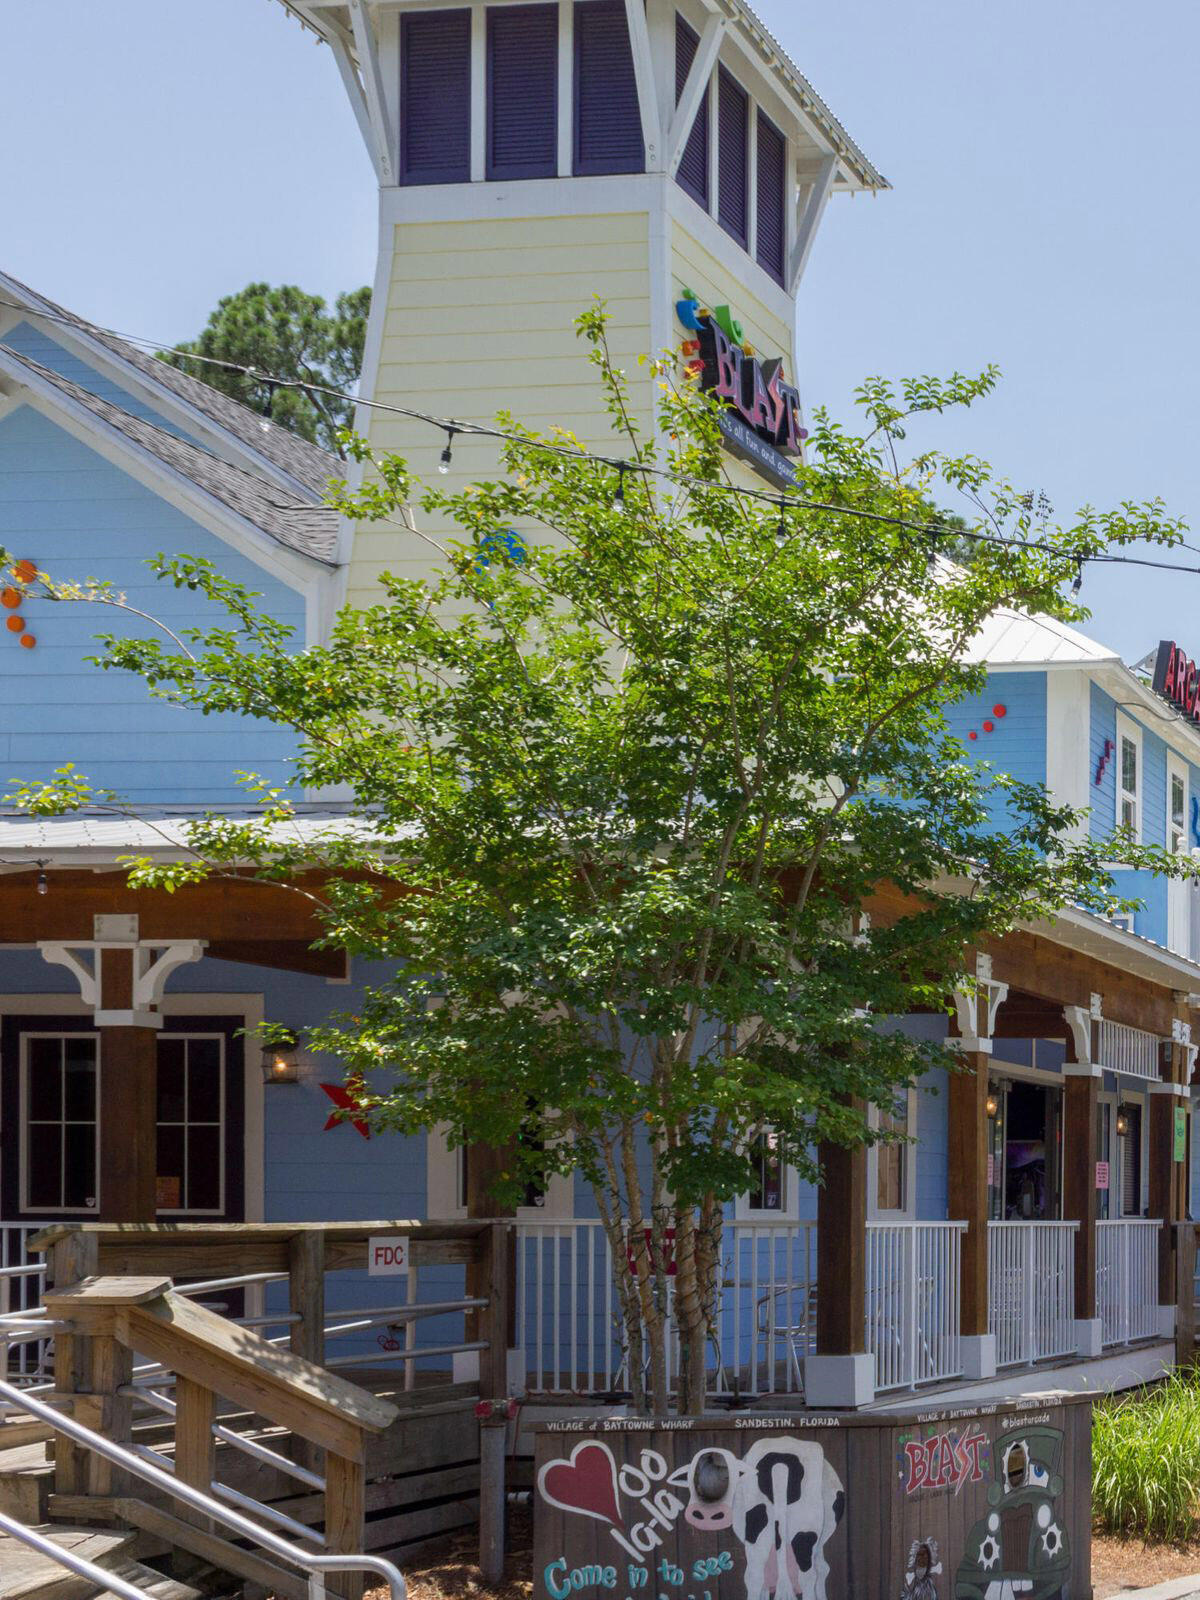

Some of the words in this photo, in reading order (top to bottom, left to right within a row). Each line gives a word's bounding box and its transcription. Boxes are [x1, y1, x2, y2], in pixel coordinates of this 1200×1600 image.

[703, 316, 801, 456] BLAST
[375, 1245, 404, 1266] FDC
[547, 1421, 583, 1431] VILLAGE
[589, 1421, 597, 1430] of
[604, 1420, 655, 1431] BAYTOWNE
[661, 1419, 695, 1430] WHARF
[800, 1417, 840, 1427] FLORIDA
[1002, 1412, 1050, 1429] #blastarcade
[905, 1424, 988, 1496] BLAST
[610, 1489, 686, 1563] la-la
[544, 1556, 617, 1600] Come
[628, 1564, 648, 1589] in
[657, 1558, 684, 1586] to
[693, 1551, 734, 1581] see
